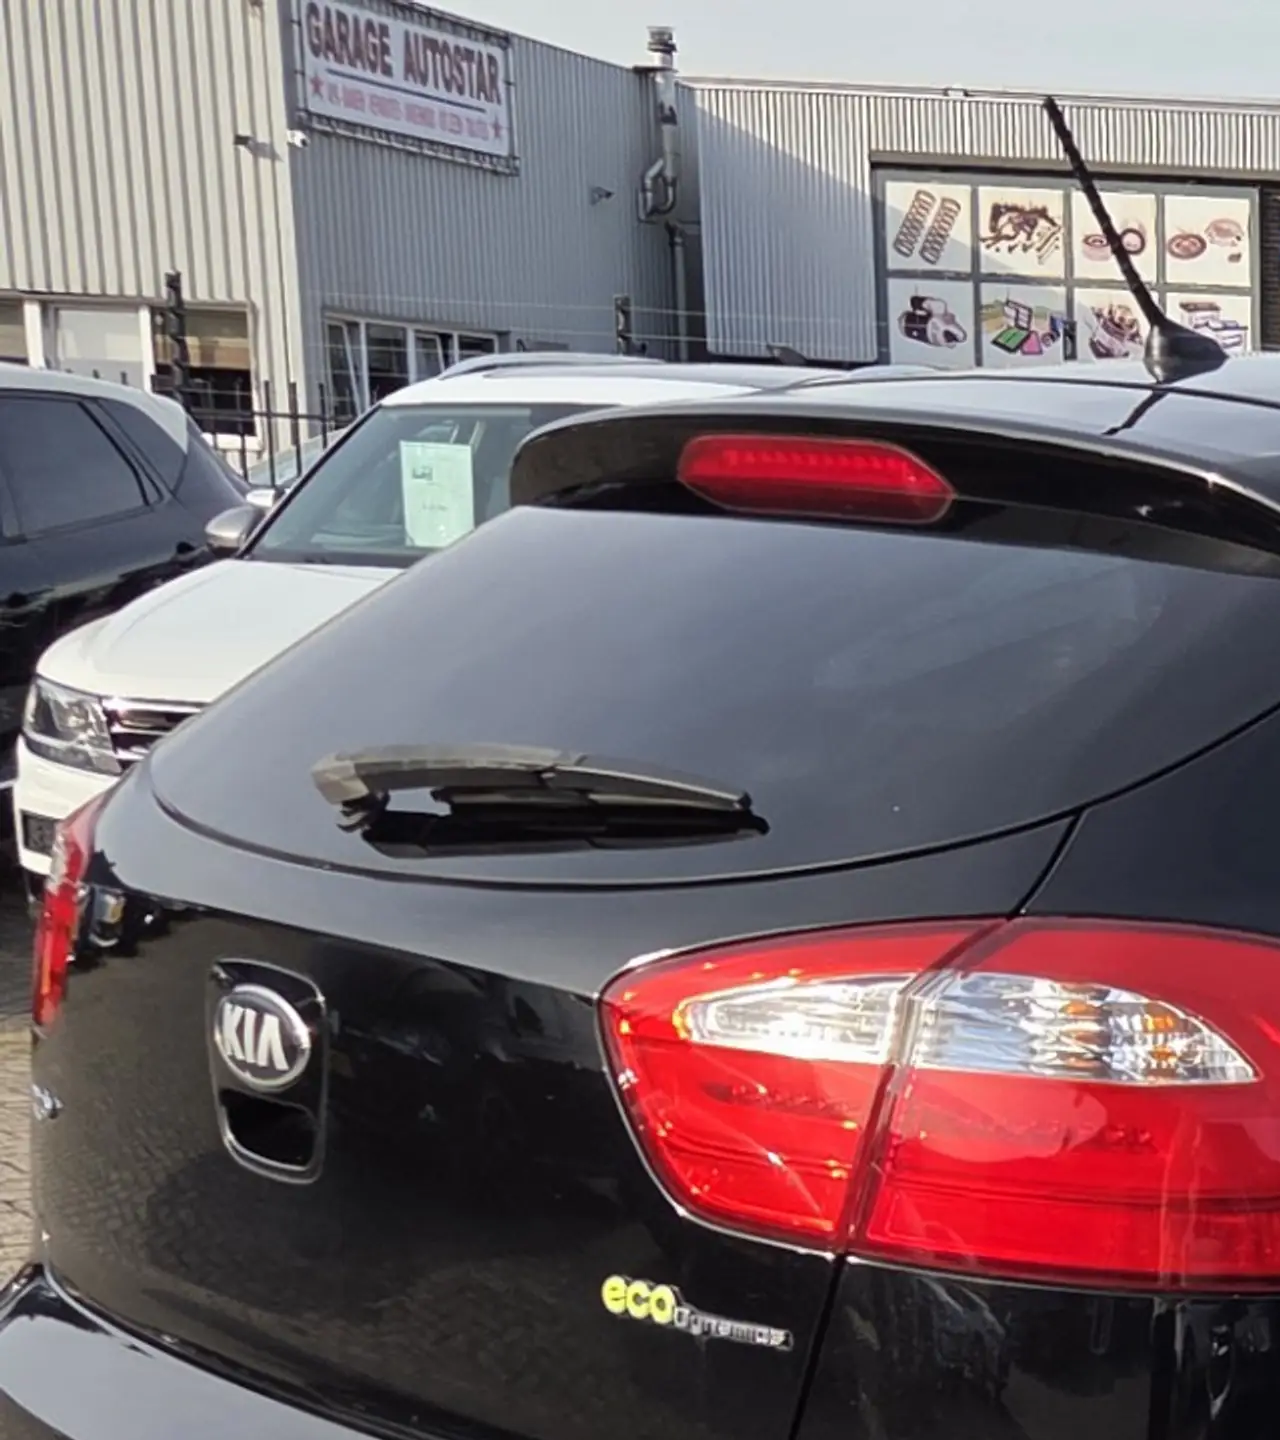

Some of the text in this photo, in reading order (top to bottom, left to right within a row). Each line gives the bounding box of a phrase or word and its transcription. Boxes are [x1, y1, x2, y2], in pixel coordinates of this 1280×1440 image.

[305, 2, 502, 105] GARAGE AUTOSTAR
[222, 1002, 289, 1071] KIA
